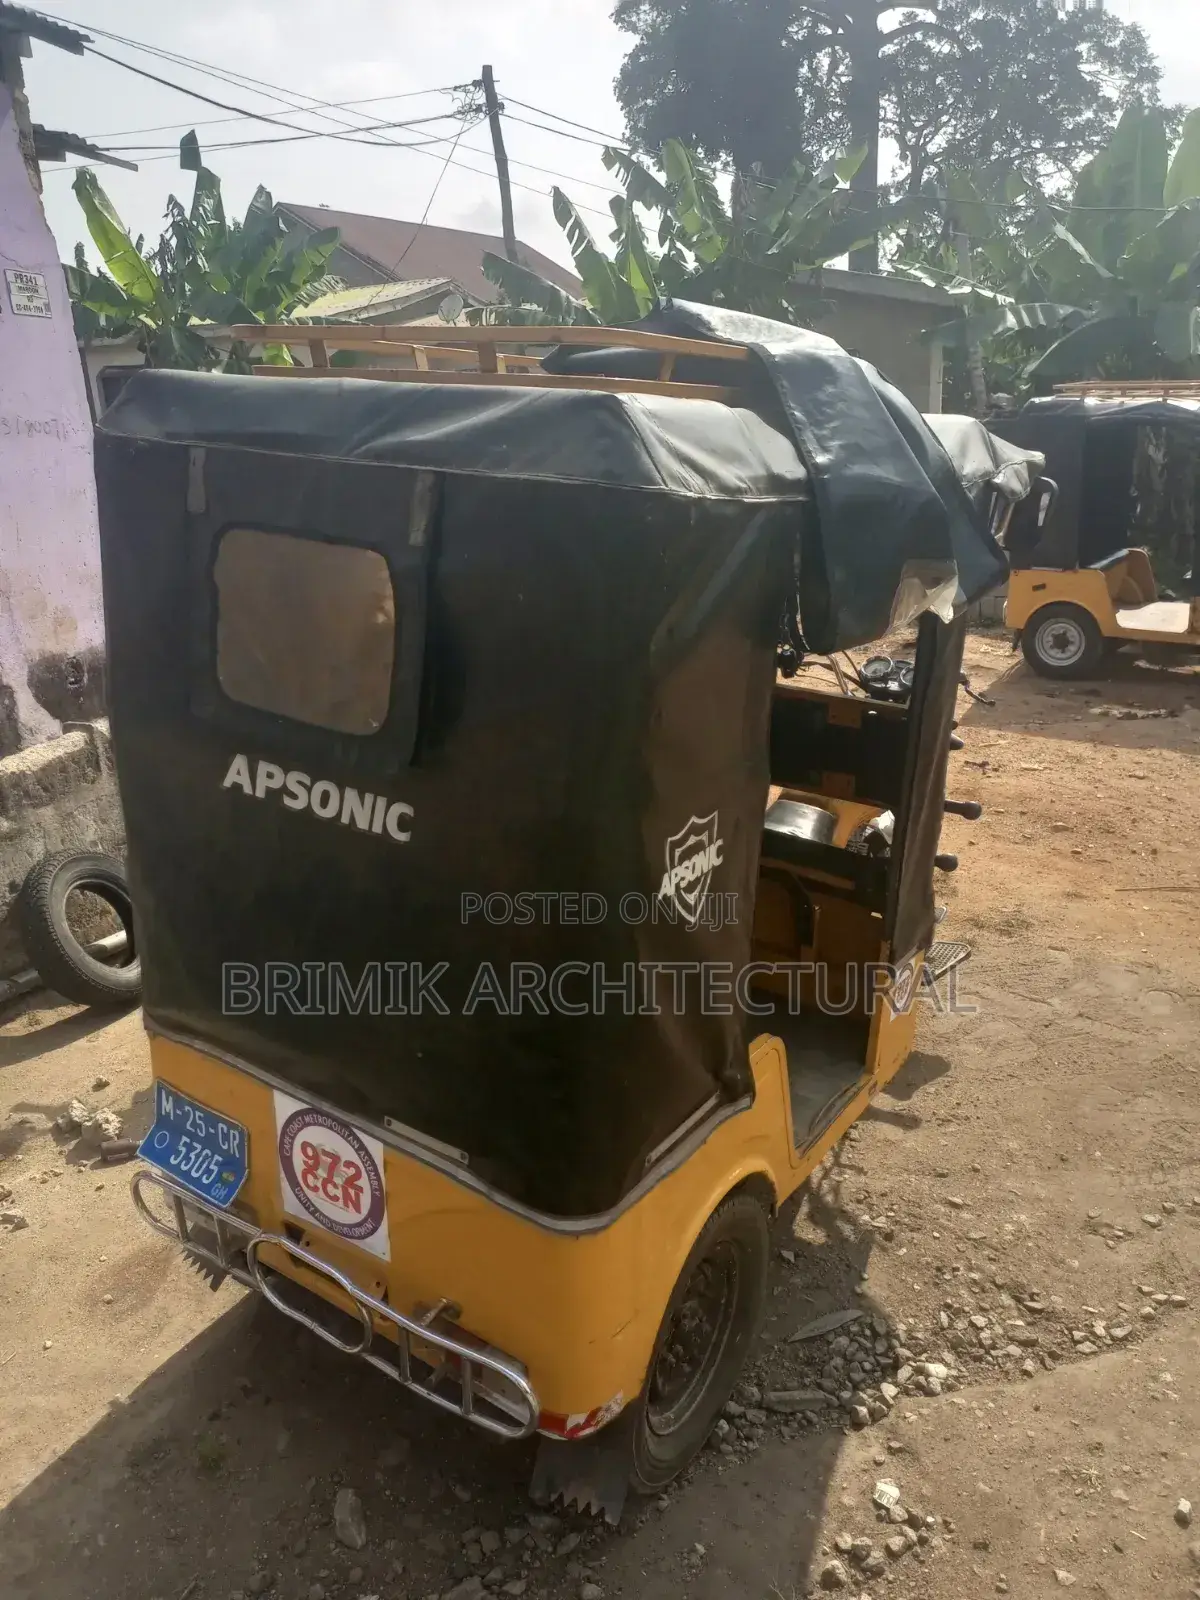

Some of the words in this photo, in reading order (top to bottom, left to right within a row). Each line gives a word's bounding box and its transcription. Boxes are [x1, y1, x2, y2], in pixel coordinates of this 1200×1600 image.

[13, 272, 38, 285] PR341
[223, 753, 415, 842] APSONIC
[658, 838, 724, 901] APSONIC
[162, 1089, 240, 1158] M-25-CR
[170, 1135, 223, 1184] 5305
[283, 1134, 293, 1157] CAPE
[288, 1115, 304, 1136] COAST
[304, 1114, 359, 1149] METROPOLITAN
[358, 1150, 381, 1197] ASSEMBLY
[300, 1140, 364, 1194] 972
[210, 1182, 229, 1199] GH
[294, 1186, 314, 1215] UNITY
[314, 1211, 331, 1228] AND
[300, 1167, 362, 1215] CCN
